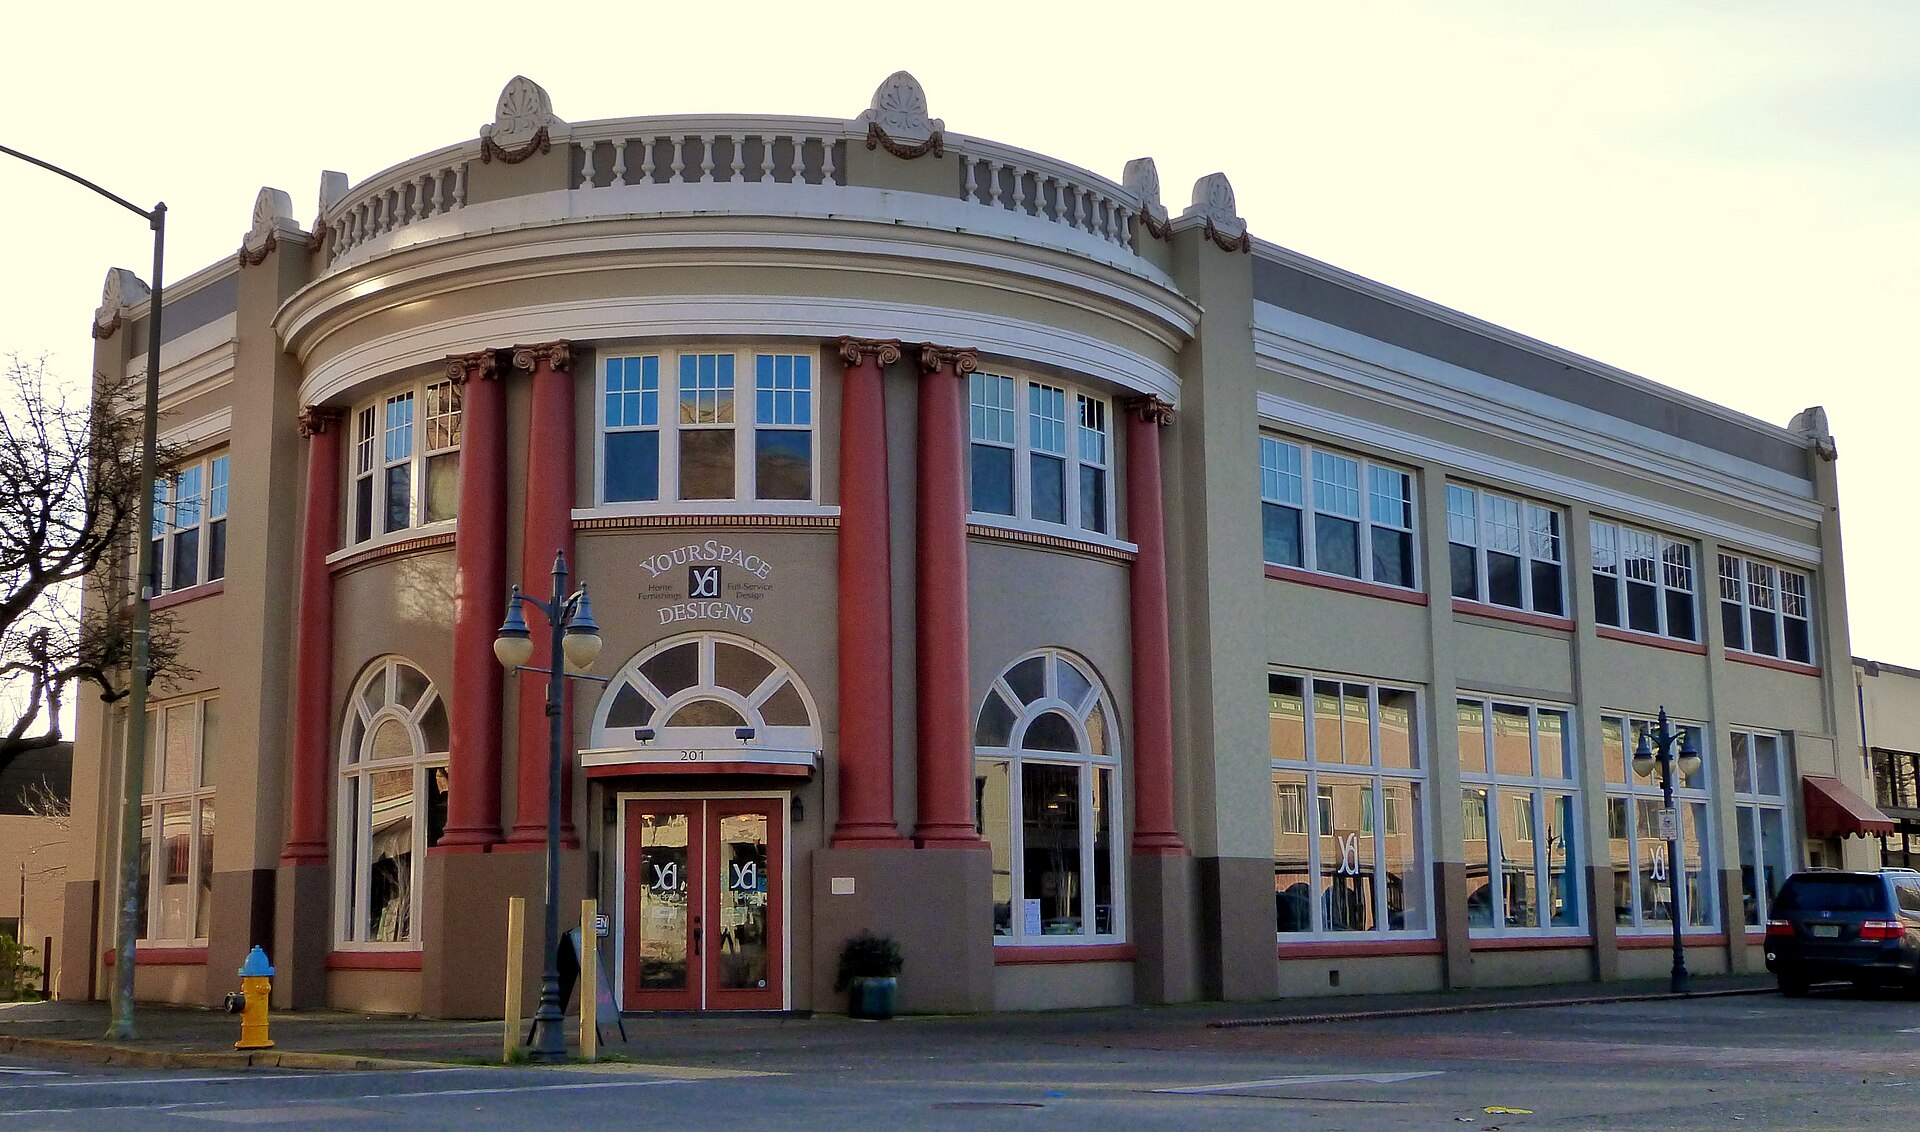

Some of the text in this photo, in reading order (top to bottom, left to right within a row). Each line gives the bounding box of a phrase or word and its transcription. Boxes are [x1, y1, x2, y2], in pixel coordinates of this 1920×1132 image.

[639, 540, 773, 579] YOURSPACE
[648, 584, 672, 592] Home
[638, 592, 682, 600] Furnishings
[736, 592, 764, 600] Design
[657, 602, 754, 625] DESIGNS
[680, 750, 704, 761] 201
